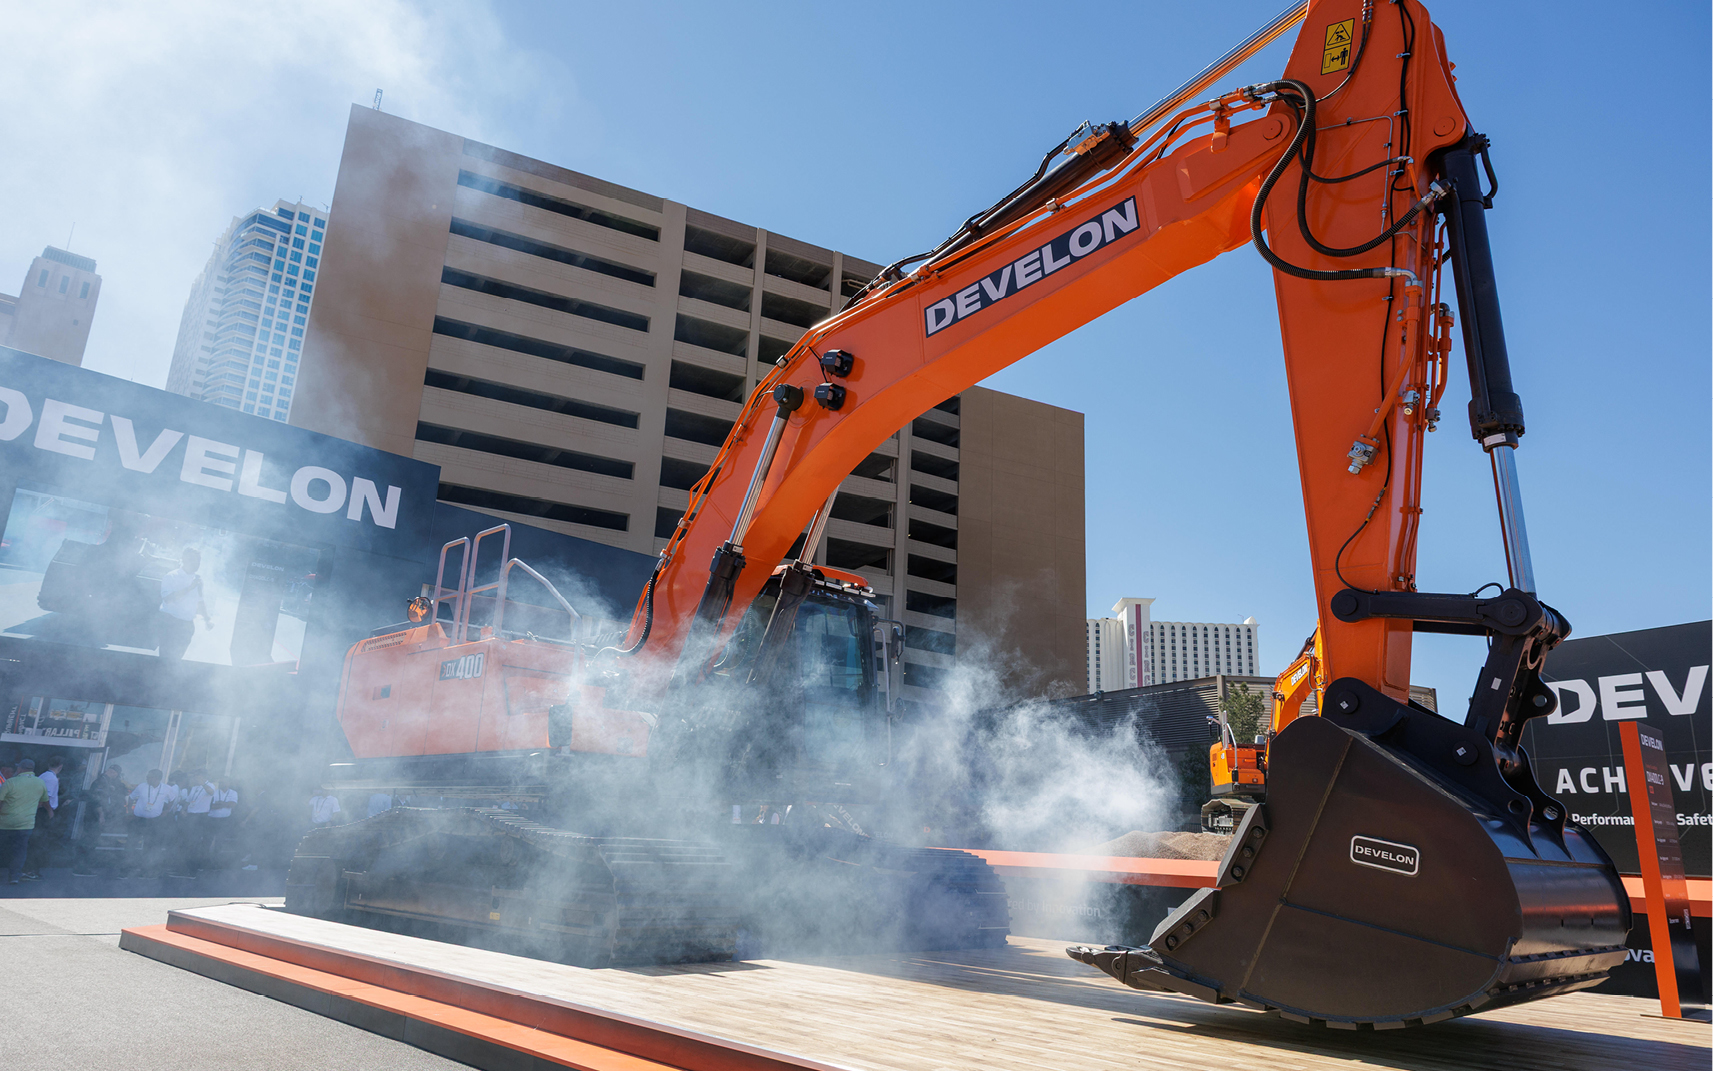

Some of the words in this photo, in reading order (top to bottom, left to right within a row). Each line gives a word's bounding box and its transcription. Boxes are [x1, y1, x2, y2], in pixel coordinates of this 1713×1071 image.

[926, 197, 1138, 336] DEVELON
[446, 653, 485, 680] DX400
[1545, 665, 1709, 725] DEV
[1355, 845, 1414, 866] DEVELON
[1027, 899, 1039, 913] by
